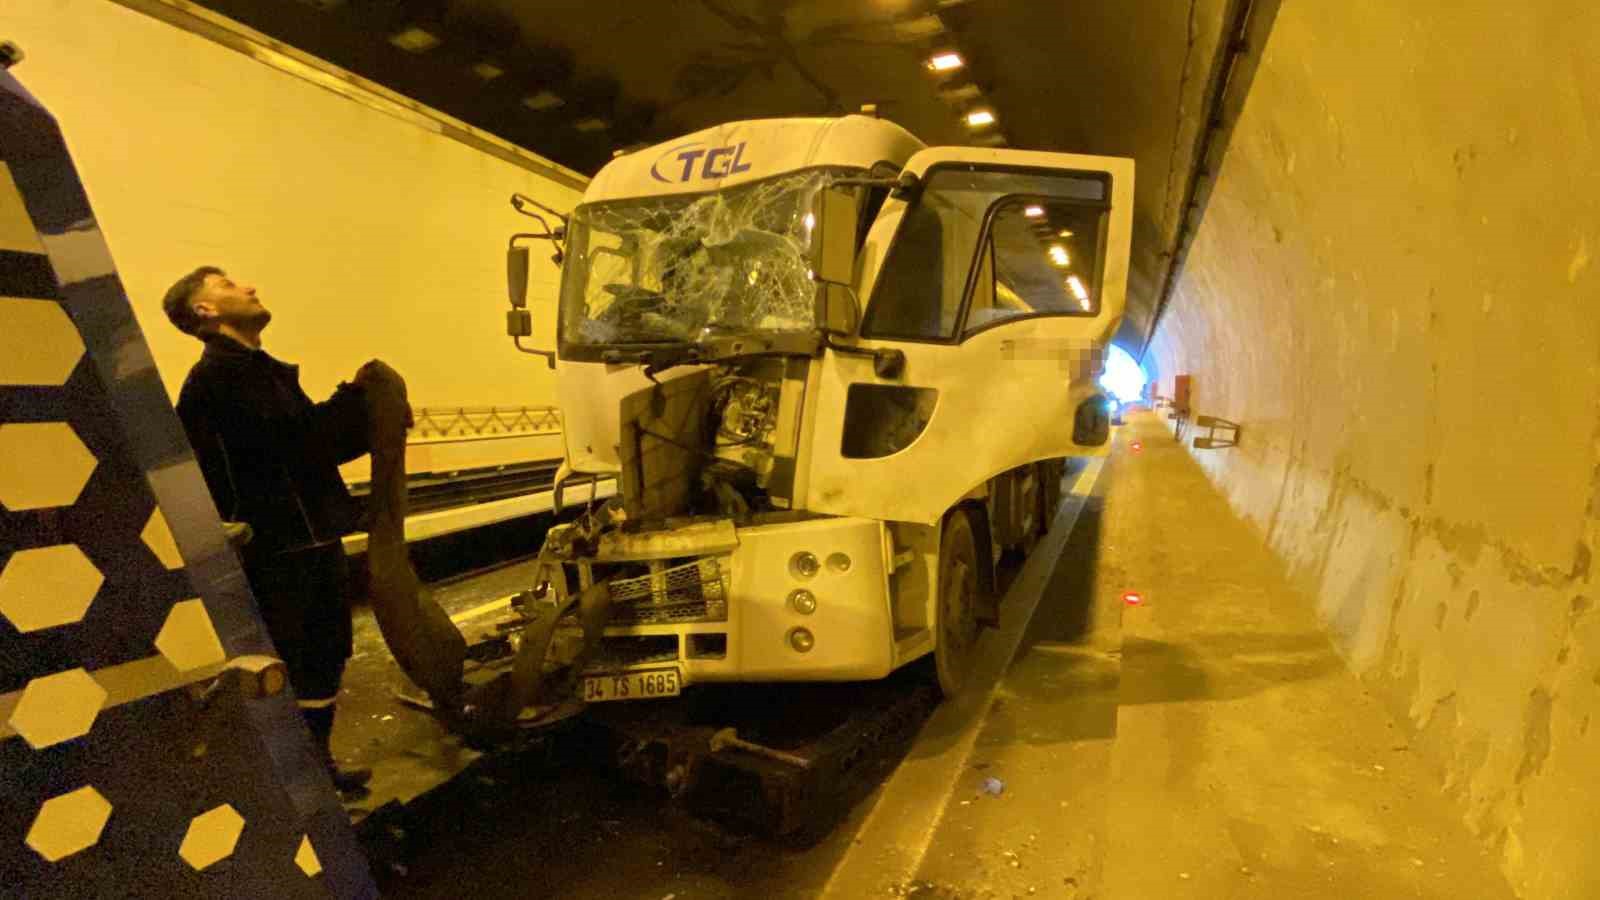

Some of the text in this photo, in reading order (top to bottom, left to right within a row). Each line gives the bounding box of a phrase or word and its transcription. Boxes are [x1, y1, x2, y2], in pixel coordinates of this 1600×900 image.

[677, 141, 752, 182] TGL
[586, 680, 604, 699] 34
[639, 673, 676, 695] 1685
